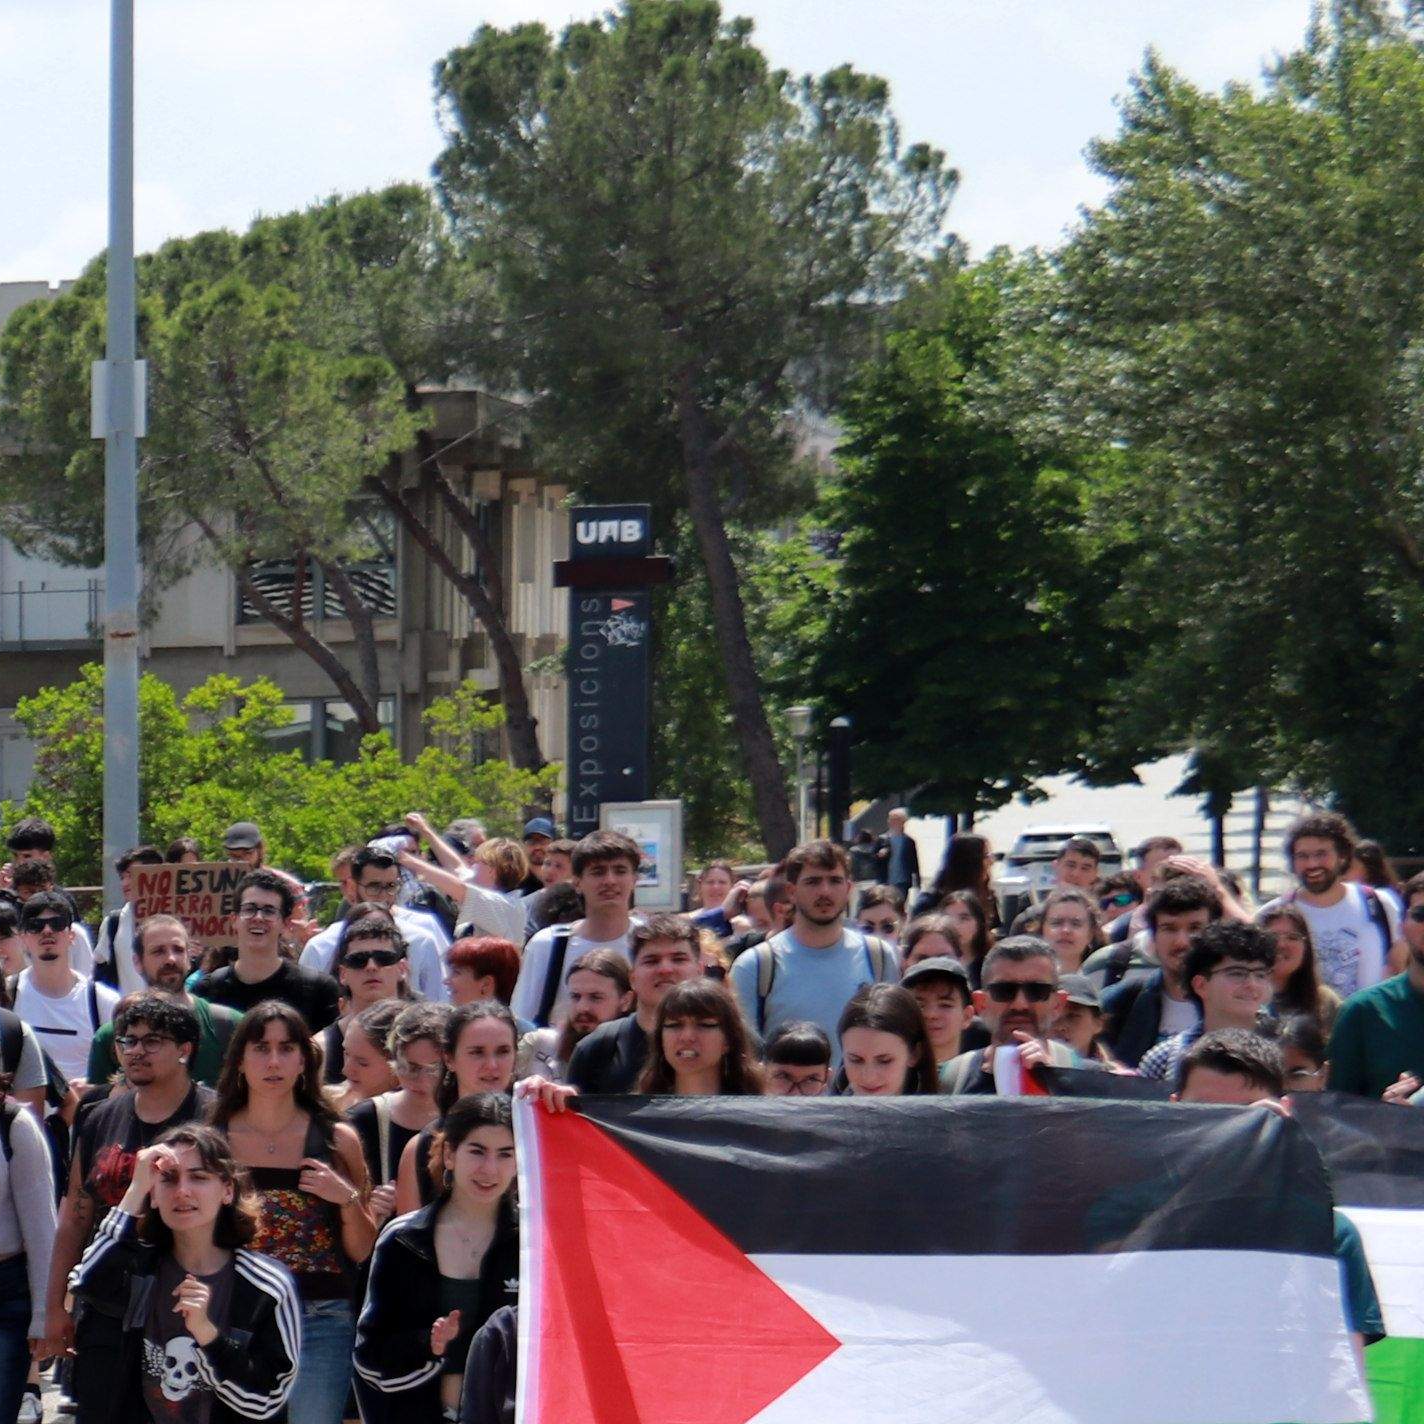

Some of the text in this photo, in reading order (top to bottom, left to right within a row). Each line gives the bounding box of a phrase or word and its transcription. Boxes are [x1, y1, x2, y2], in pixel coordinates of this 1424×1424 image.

[576, 519, 642, 544] UAB
[573, 598, 603, 823] Exposicions
[138, 870, 171, 897] NO
[175, 869, 207, 895] ES
